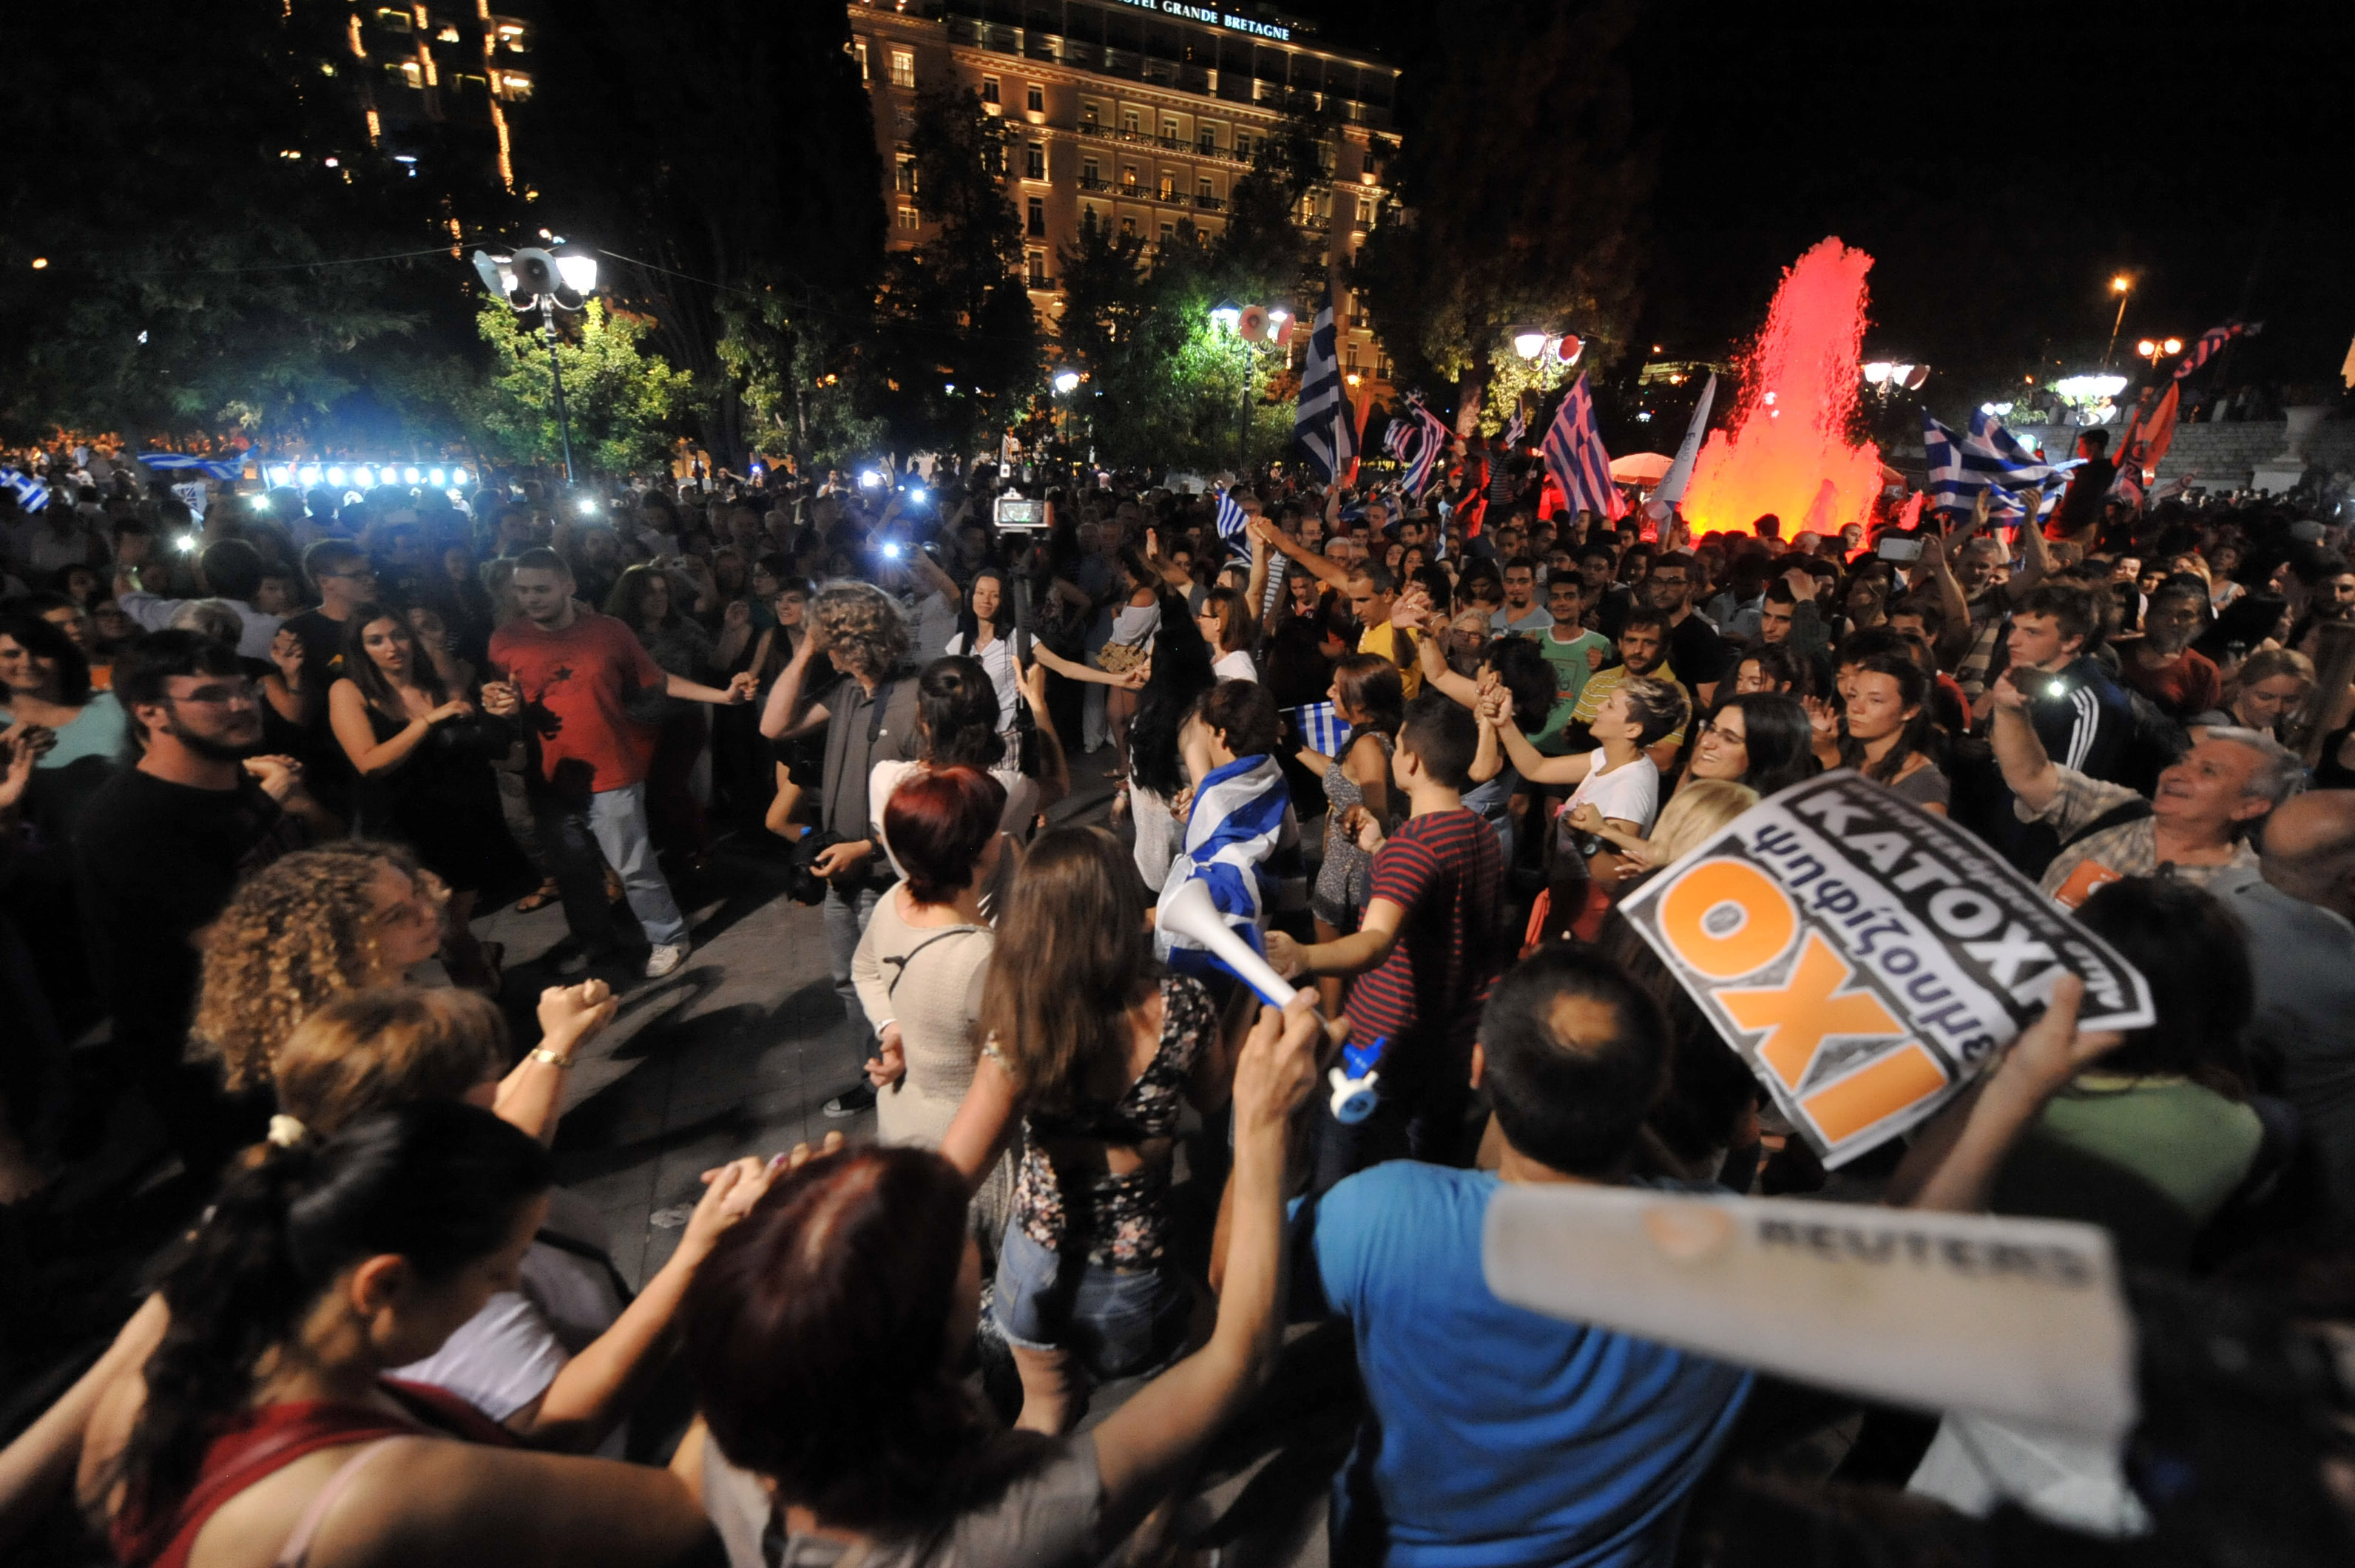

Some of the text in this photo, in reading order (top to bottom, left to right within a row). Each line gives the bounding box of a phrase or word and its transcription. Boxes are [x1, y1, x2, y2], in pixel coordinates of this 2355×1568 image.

[1118, 0, 1289, 41] TEL GRANDE BRETAGNE
[1658, 856, 1948, 1143] ΟΧΙ
[1751, 823, 1996, 1061] ψηφίζουμε
